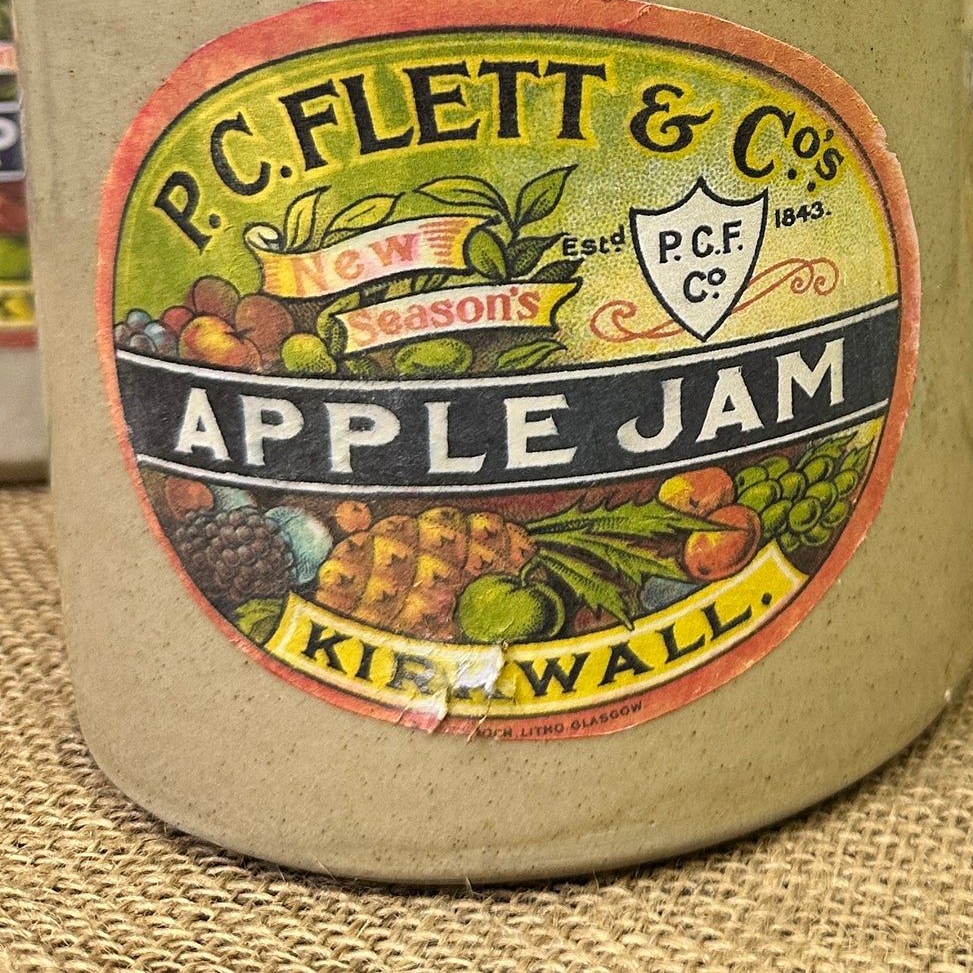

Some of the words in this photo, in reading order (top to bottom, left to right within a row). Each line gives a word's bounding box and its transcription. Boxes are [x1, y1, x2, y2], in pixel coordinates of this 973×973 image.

[630, 83, 715, 153] &
[291, 232, 420, 297] New
[350, 287, 542, 347] Season's
[174, 387, 579, 474] APPLE
[618, 353, 846, 455] JAM
[570, 700, 643, 732] GLASGOW
